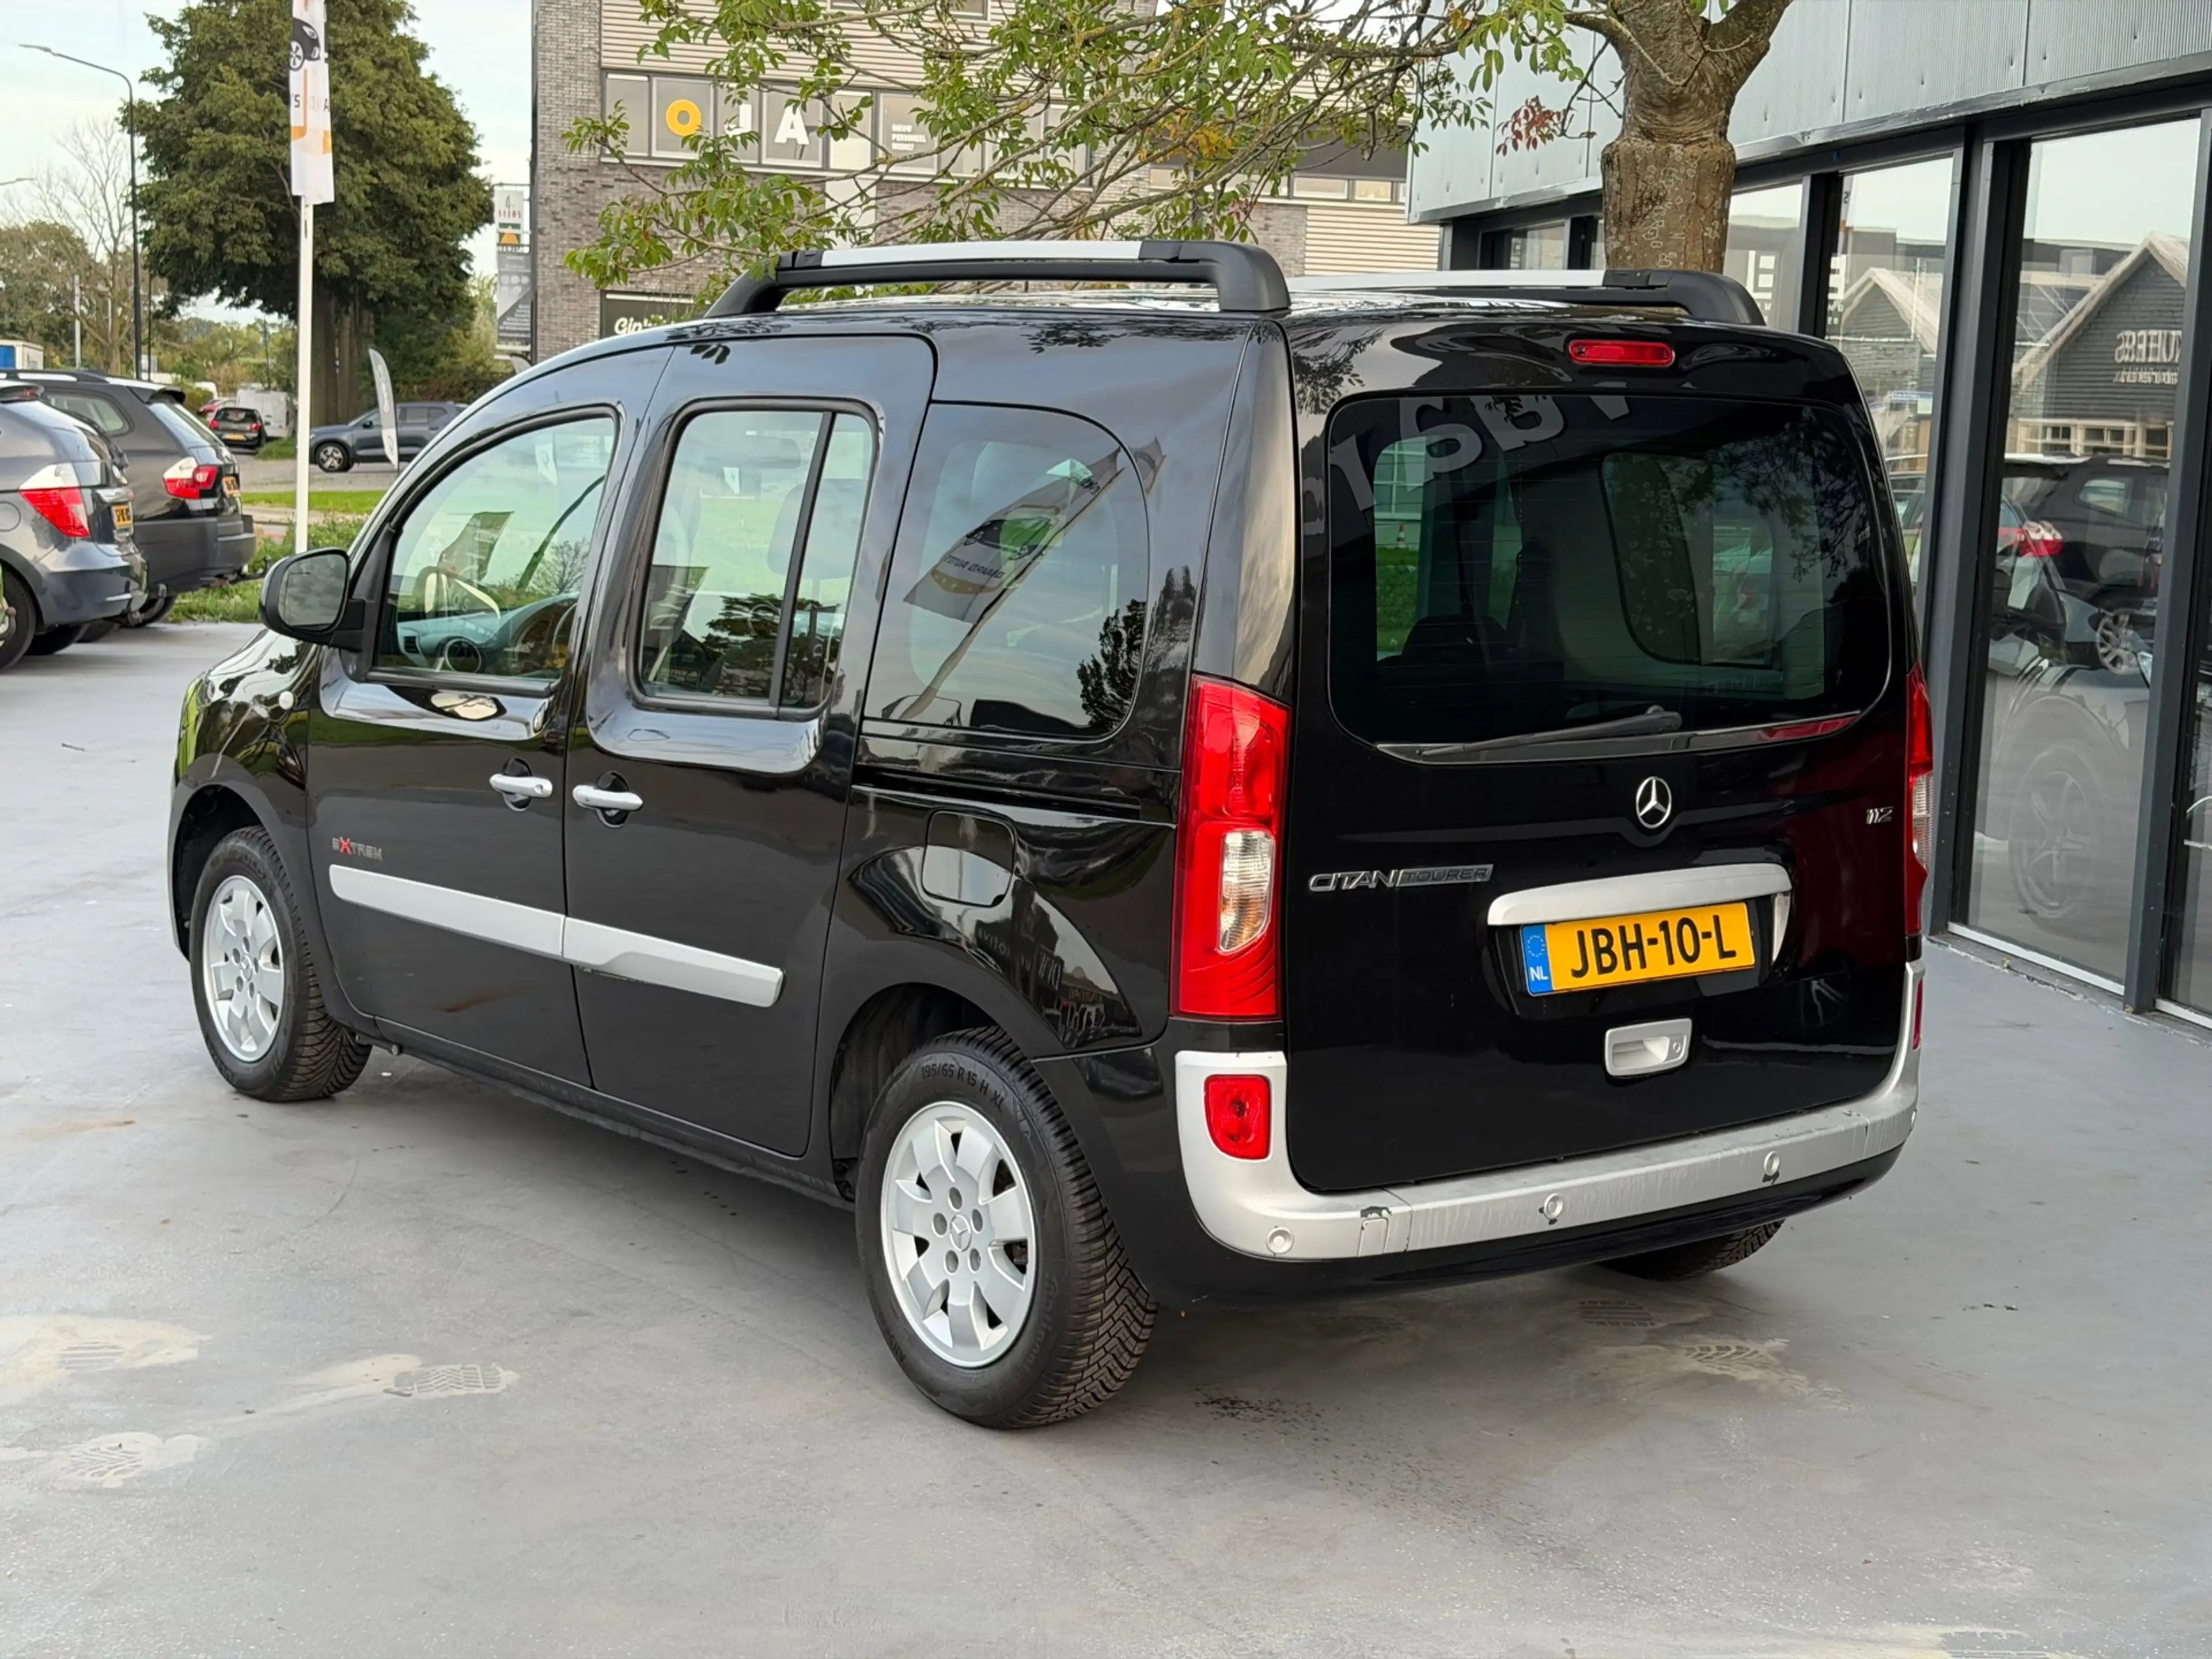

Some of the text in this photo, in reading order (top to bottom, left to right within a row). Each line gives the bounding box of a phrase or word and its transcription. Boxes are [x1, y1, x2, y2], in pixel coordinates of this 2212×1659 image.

[1866, 806, 1893, 824] 112
[1309, 868, 1488, 892] CITAN TOURER
[1571, 915, 1737, 978] JBH-10-L
[1529, 965, 1548, 982] NL
[922, 1062, 955, 1080] 195/65
